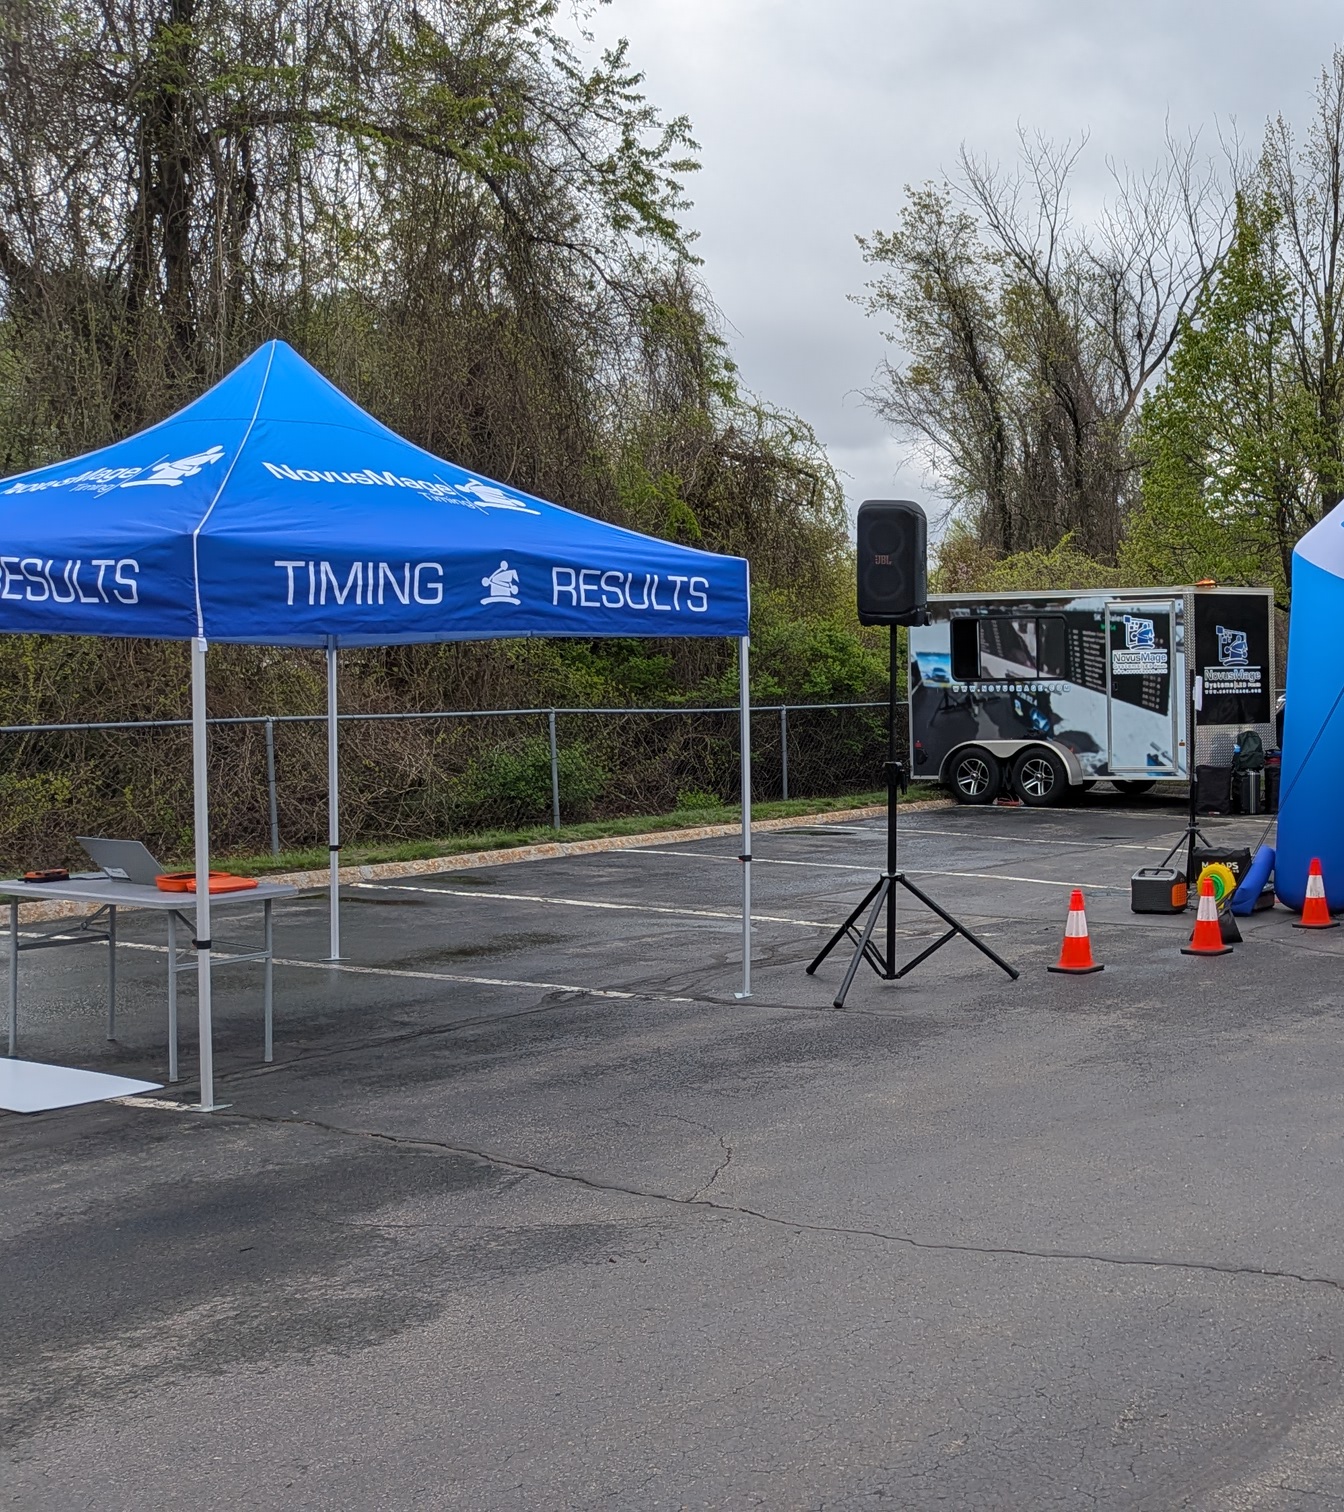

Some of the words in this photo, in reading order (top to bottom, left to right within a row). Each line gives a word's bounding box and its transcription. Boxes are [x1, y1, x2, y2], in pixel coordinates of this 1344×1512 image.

[262, 462, 457, 496] NovusMage
[417, 491, 476, 509] Timing
[874, 554, 892, 565] JBL
[0, 556, 140, 605] ESULTS
[274, 560, 444, 606] TIMING
[552, 566, 709, 612] RESULTS
[1113, 652, 1167, 663] NovusMage
[1204, 669, 1262, 682] NovusMage
